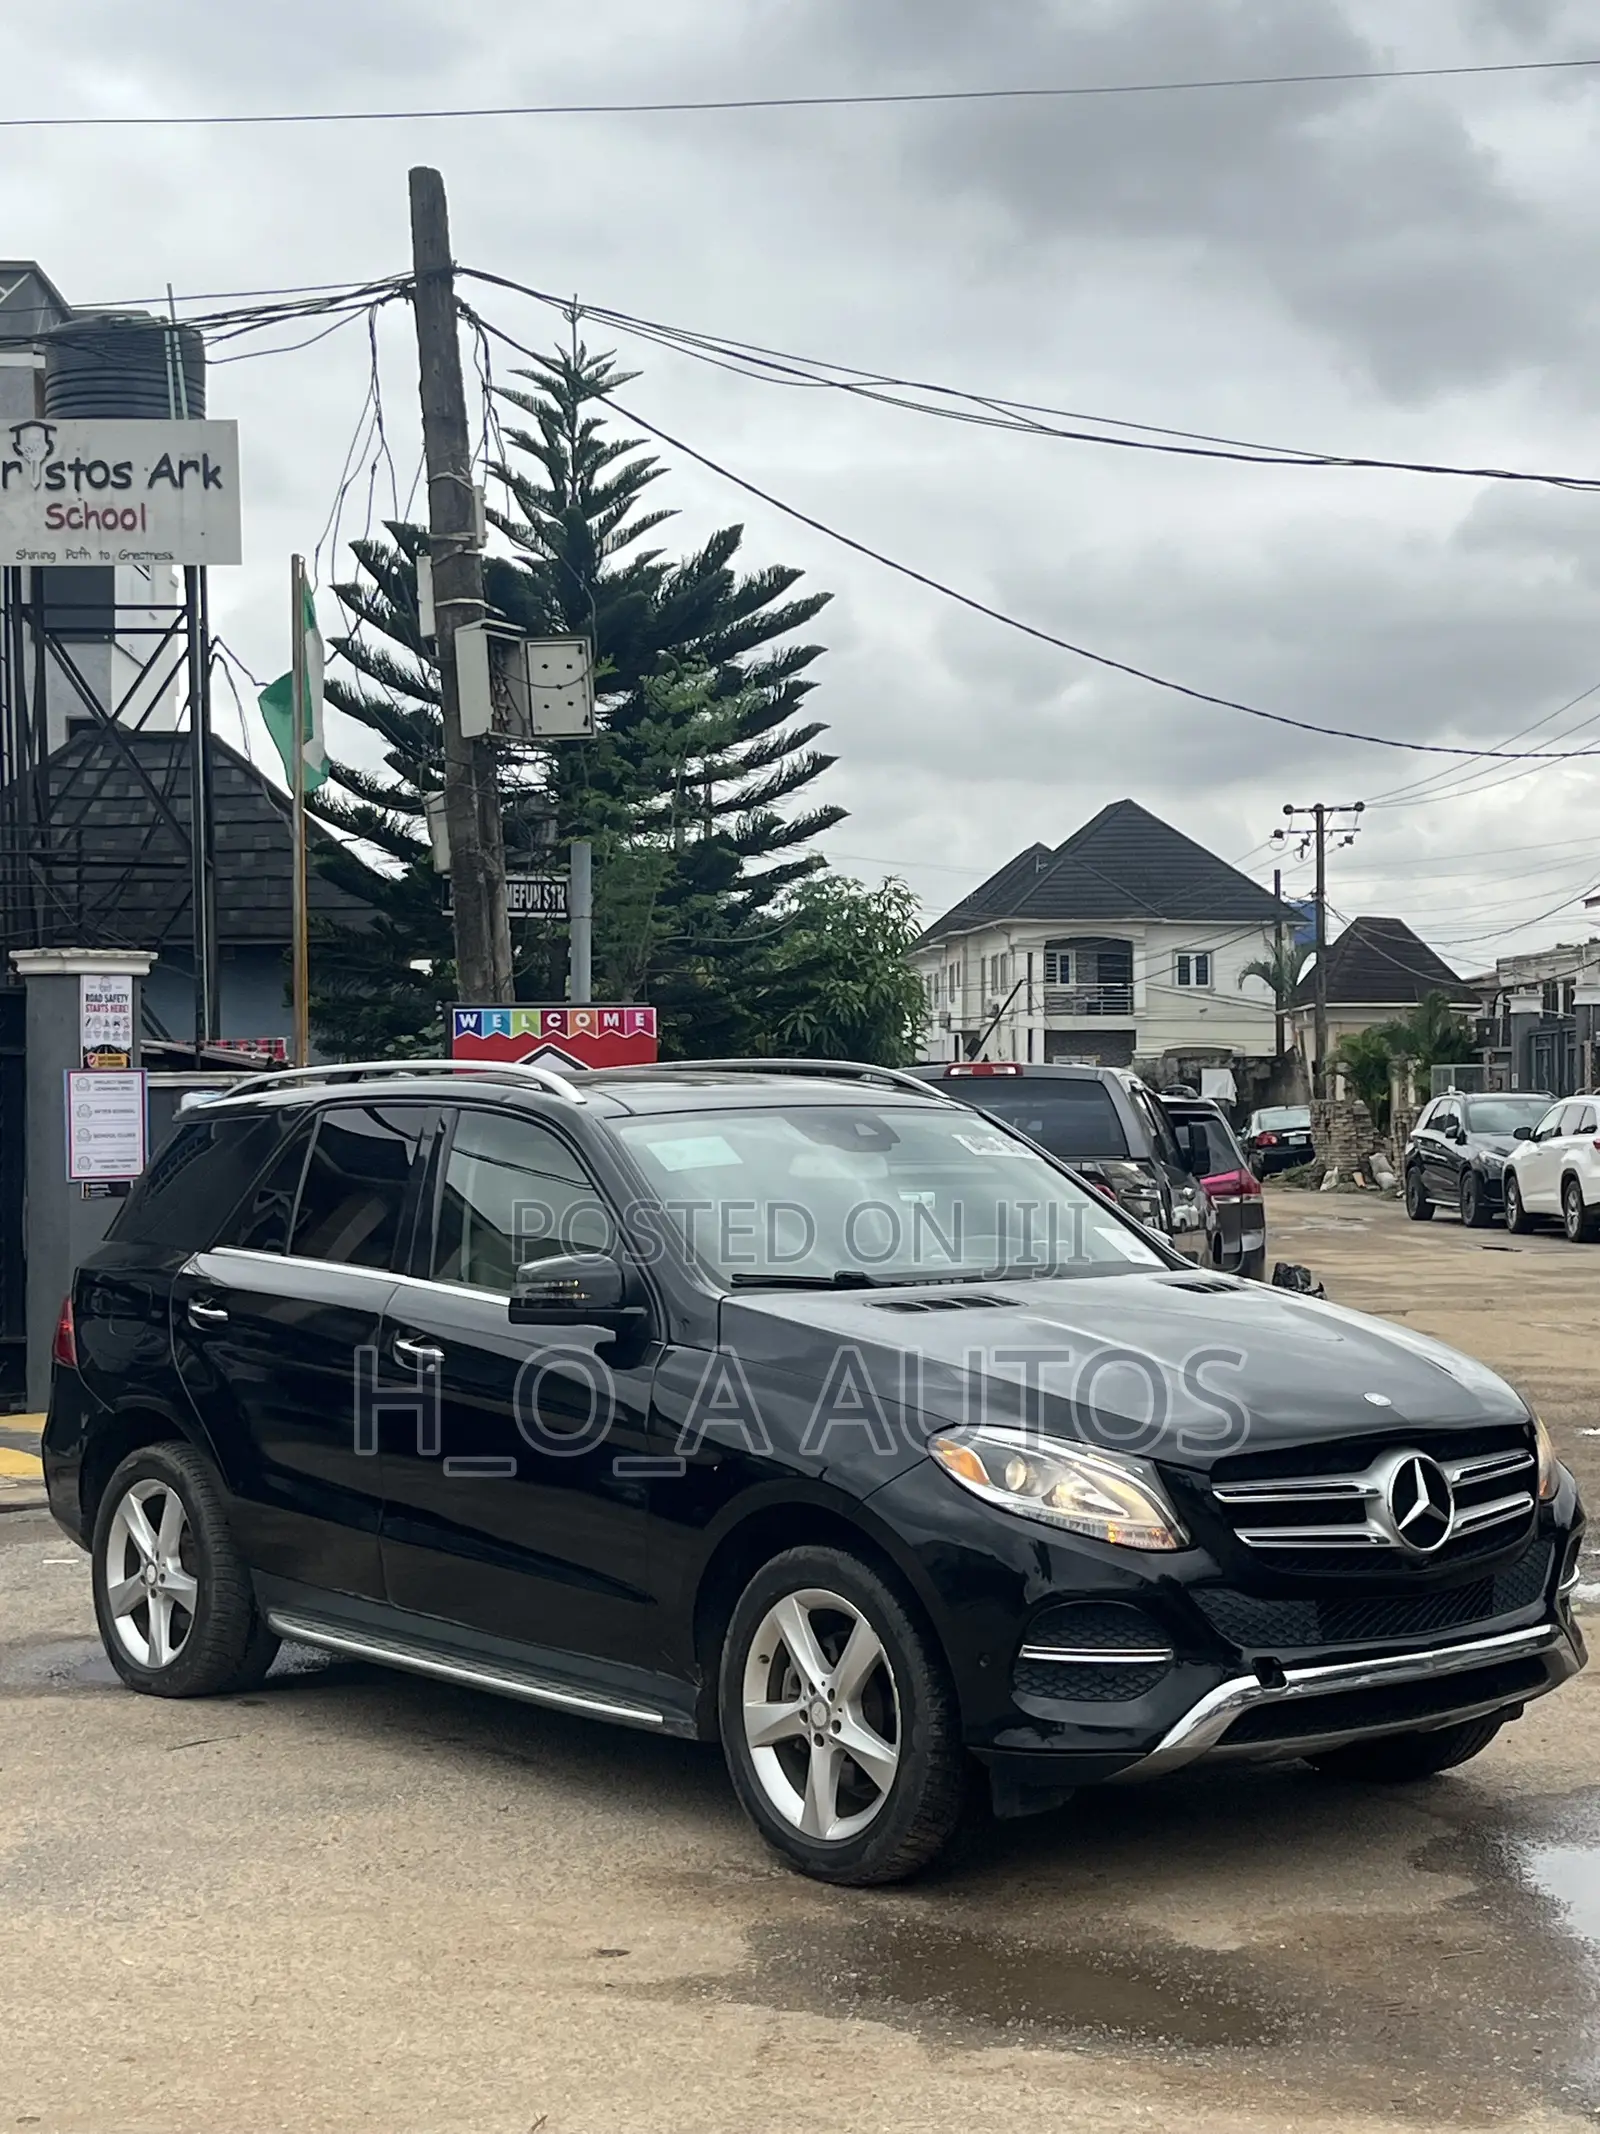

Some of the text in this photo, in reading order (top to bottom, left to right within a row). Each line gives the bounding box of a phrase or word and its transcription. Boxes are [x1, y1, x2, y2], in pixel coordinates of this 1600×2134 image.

[147, 452, 224, 490] Ark
[44, 501, 147, 533] School
[15, 546, 174, 563] Shining Path to Greatness
[85, 994, 129, 1003] ROAD SAFETY
[85, 1004, 109, 1013] STARTS
[458, 1012, 645, 1029] WELCOME
